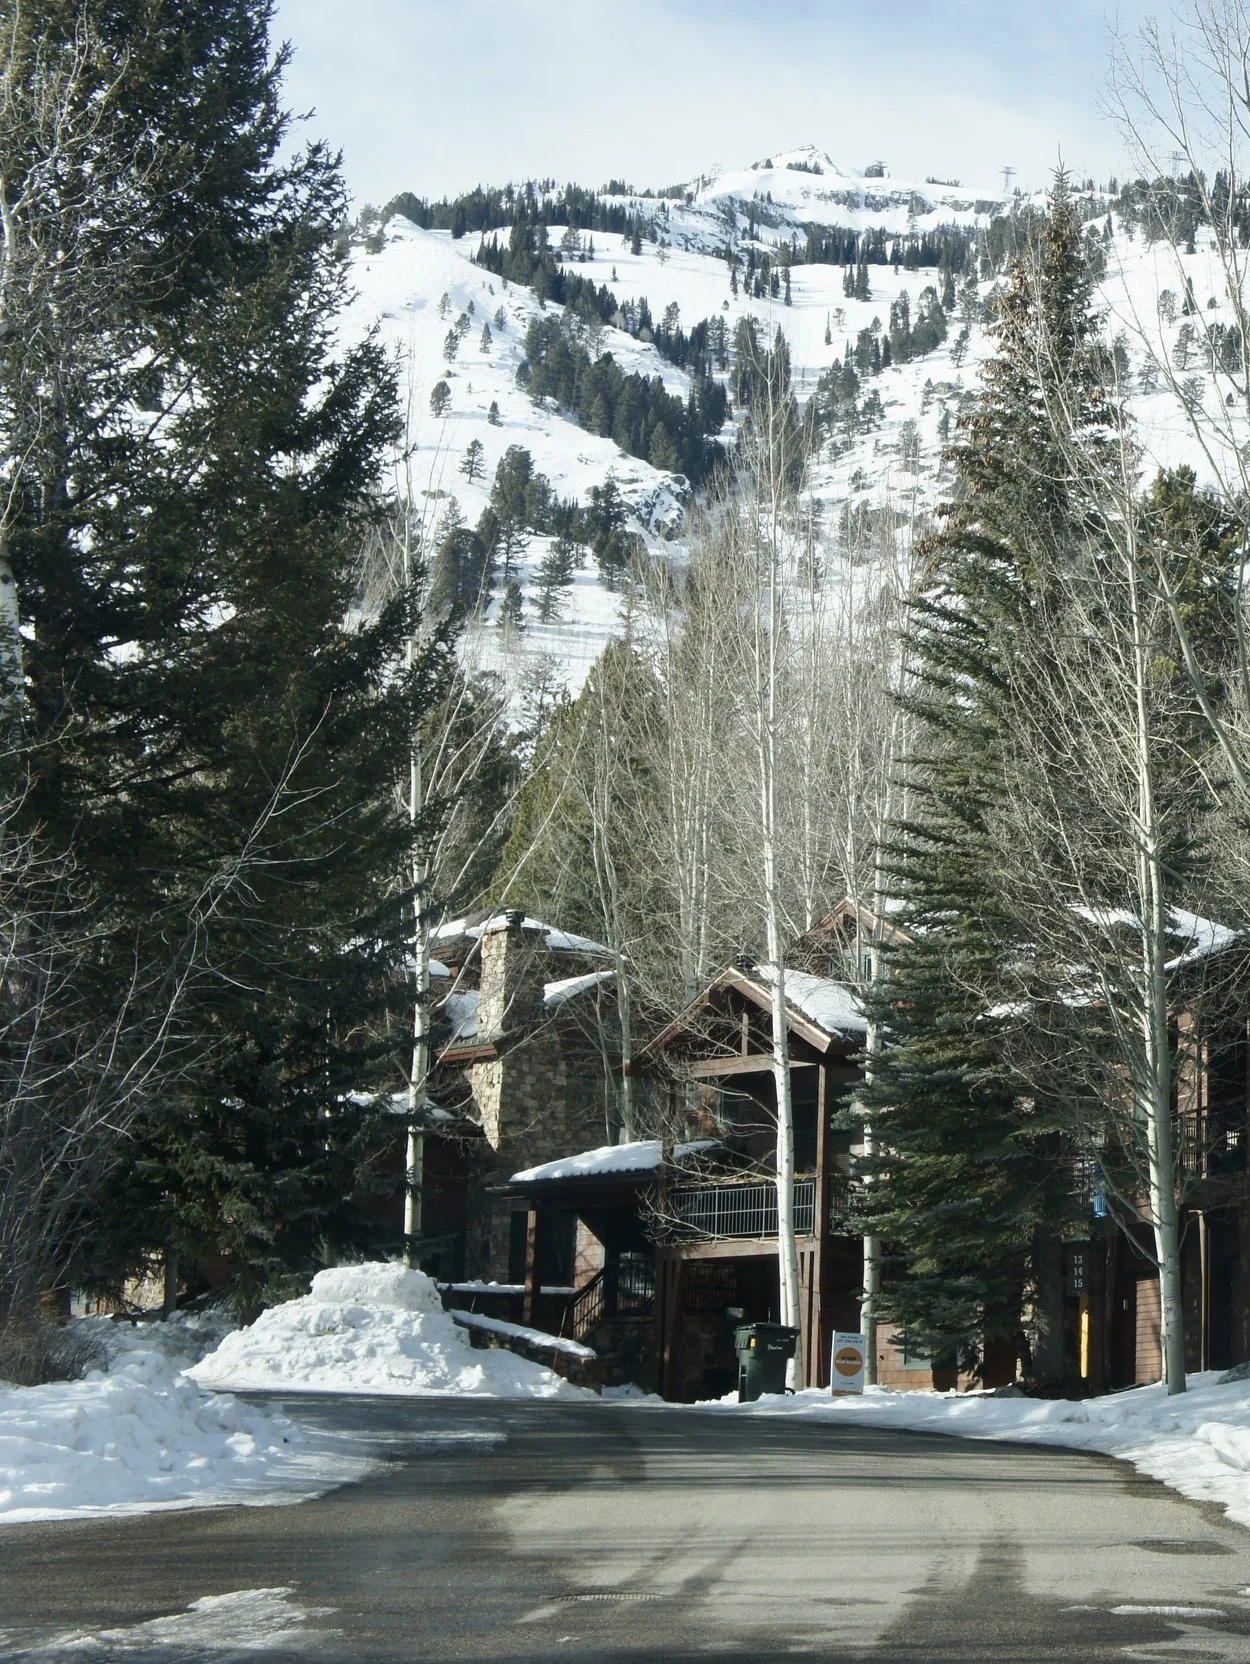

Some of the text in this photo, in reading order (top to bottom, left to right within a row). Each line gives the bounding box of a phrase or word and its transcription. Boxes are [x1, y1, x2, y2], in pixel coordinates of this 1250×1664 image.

[1074, 1255, 1083, 1264] 13
[1074, 1267, 1083, 1276] 14
[1074, 1278, 1083, 1288] 15
